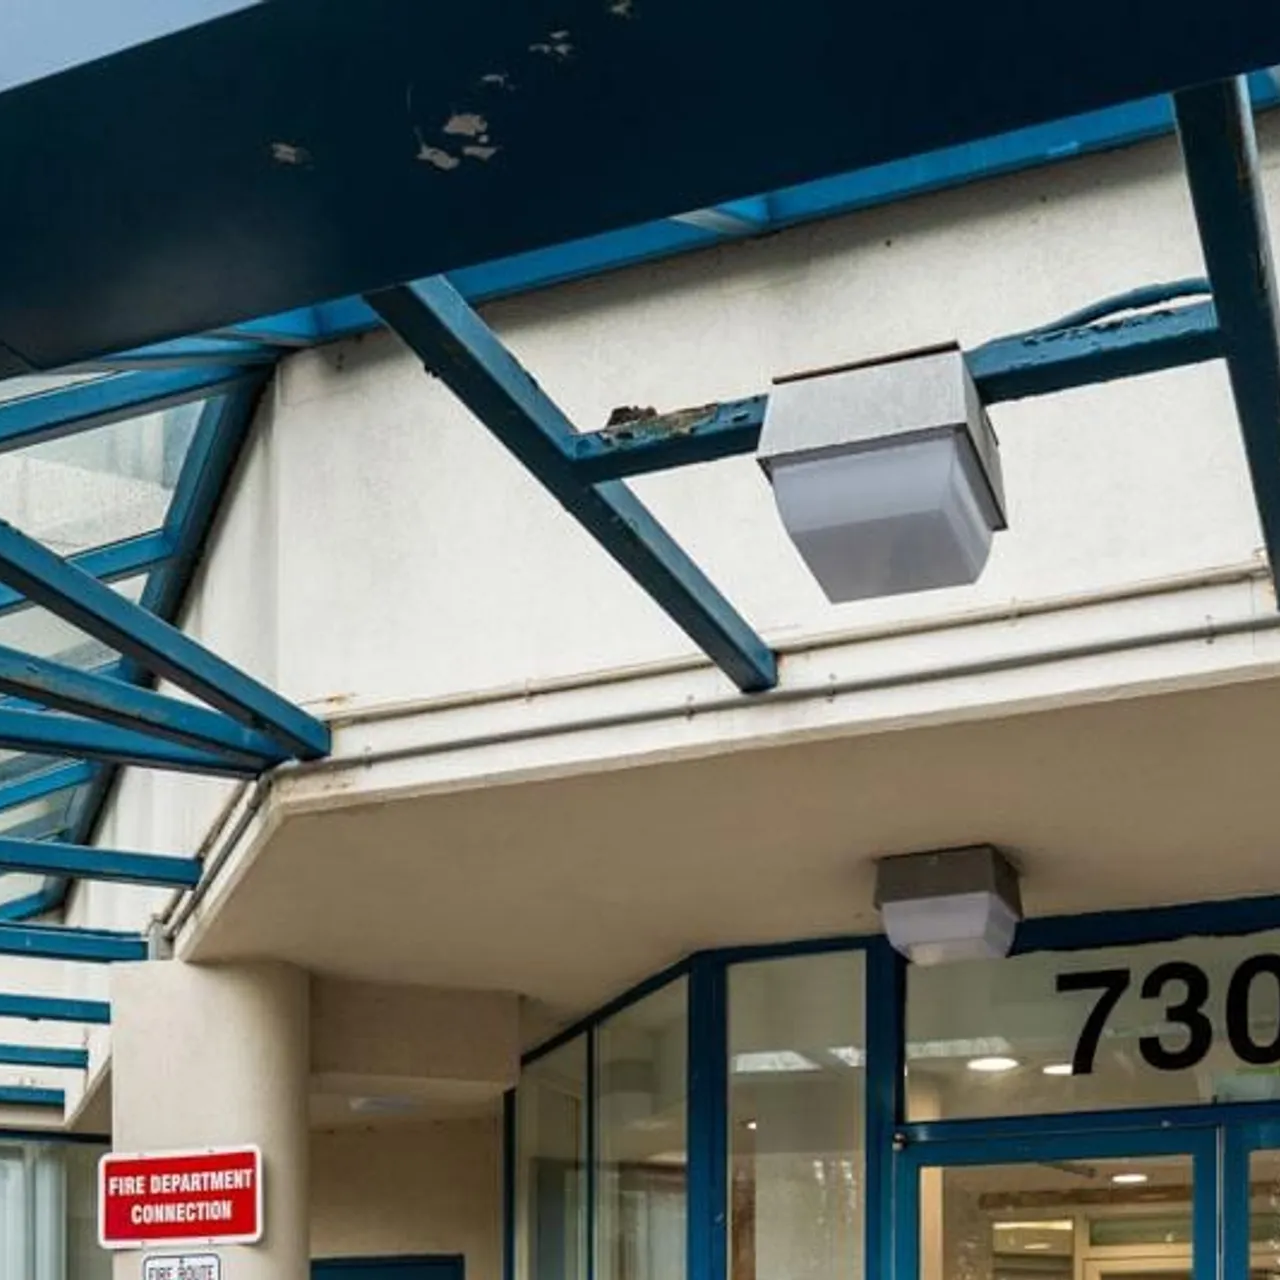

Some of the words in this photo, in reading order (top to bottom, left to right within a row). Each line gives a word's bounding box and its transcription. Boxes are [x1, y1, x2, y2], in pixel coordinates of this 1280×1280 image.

[108, 1175, 145, 1196] FIRE
[150, 1168, 253, 1194] DEPARTMENT
[131, 1200, 233, 1225] CONNECTION
